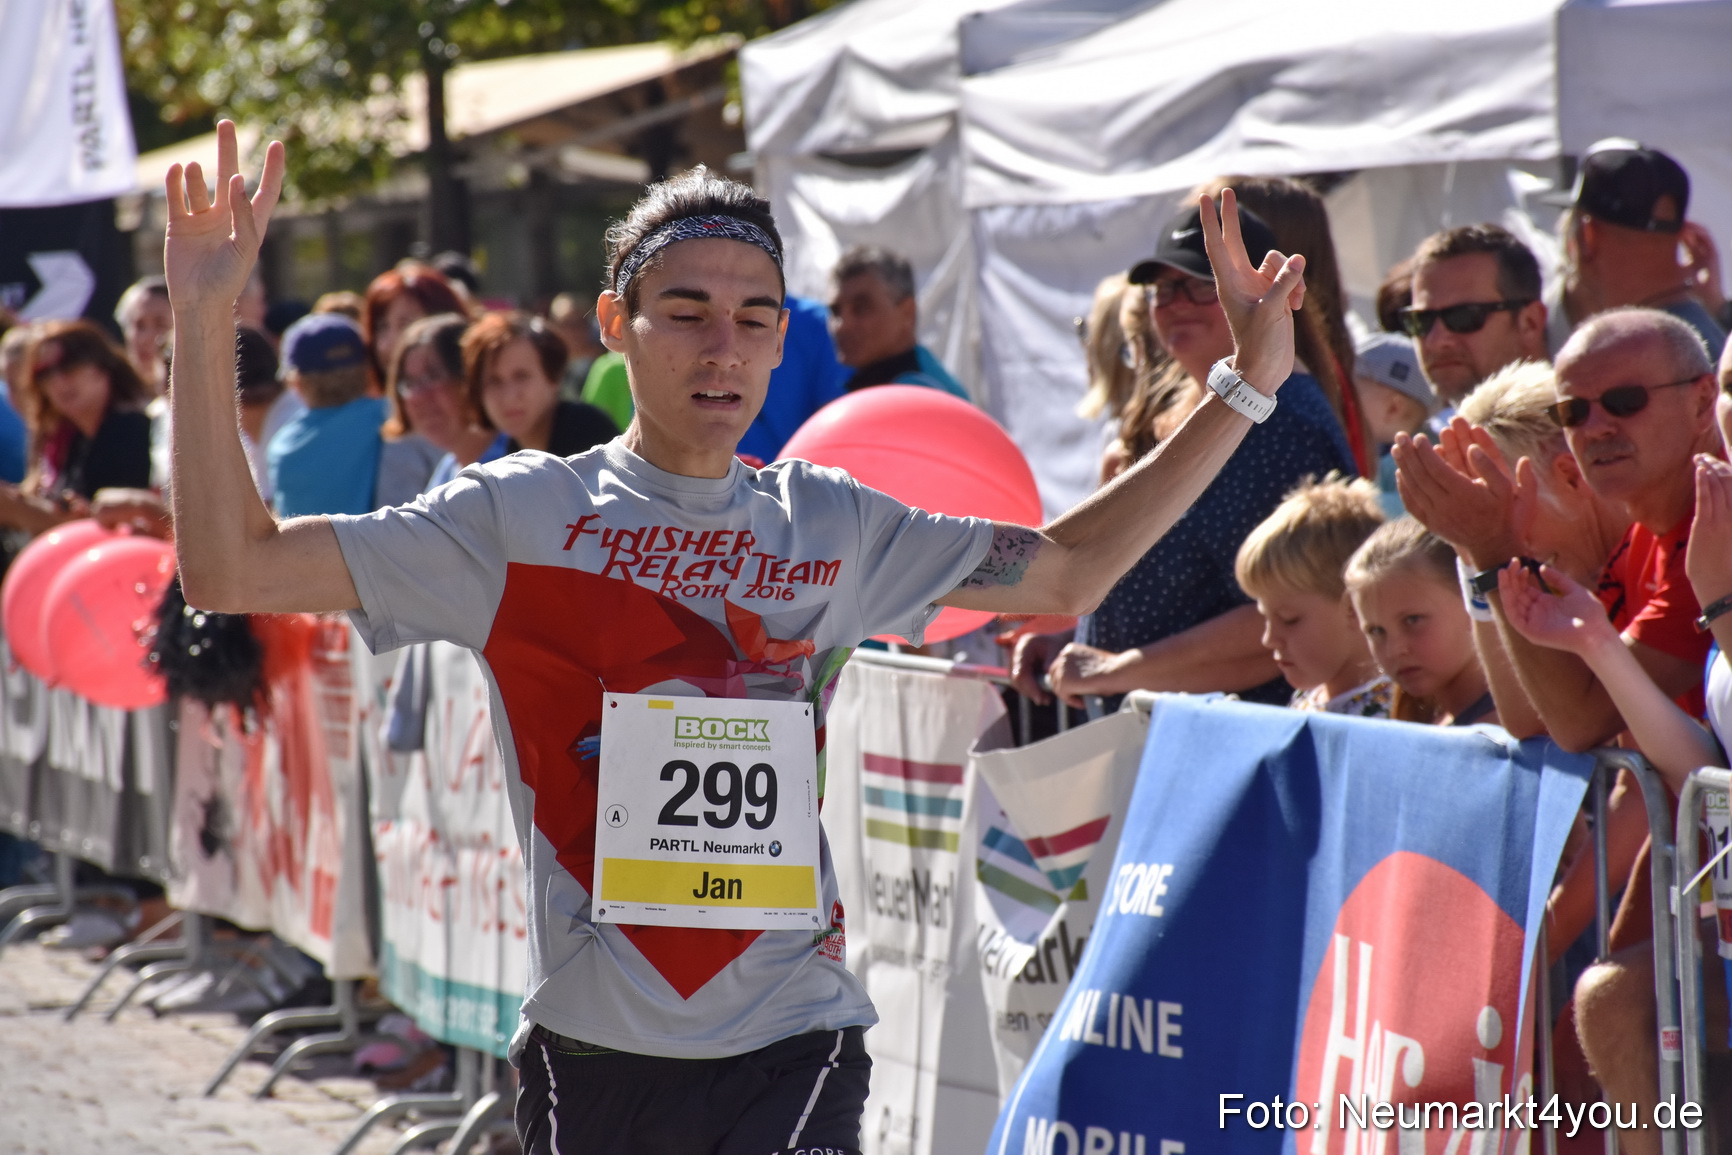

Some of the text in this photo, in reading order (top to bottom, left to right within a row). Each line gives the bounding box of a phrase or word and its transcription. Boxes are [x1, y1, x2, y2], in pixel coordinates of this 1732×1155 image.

[600, 546, 842, 588] RELAY TEAM
[658, 575, 796, 601] ROTH 2016
[674, 716, 770, 742] BOCK
[674, 741, 705, 750] inspired
[707, 743, 717, 752] by
[743, 745, 771, 753] concepts
[658, 760, 778, 830] 299
[611, 810, 622, 823] A
[650, 838, 764, 855] PARTL Neumarkt
[693, 872, 742, 900] Jan
[1106, 863, 1174, 917] STORE
